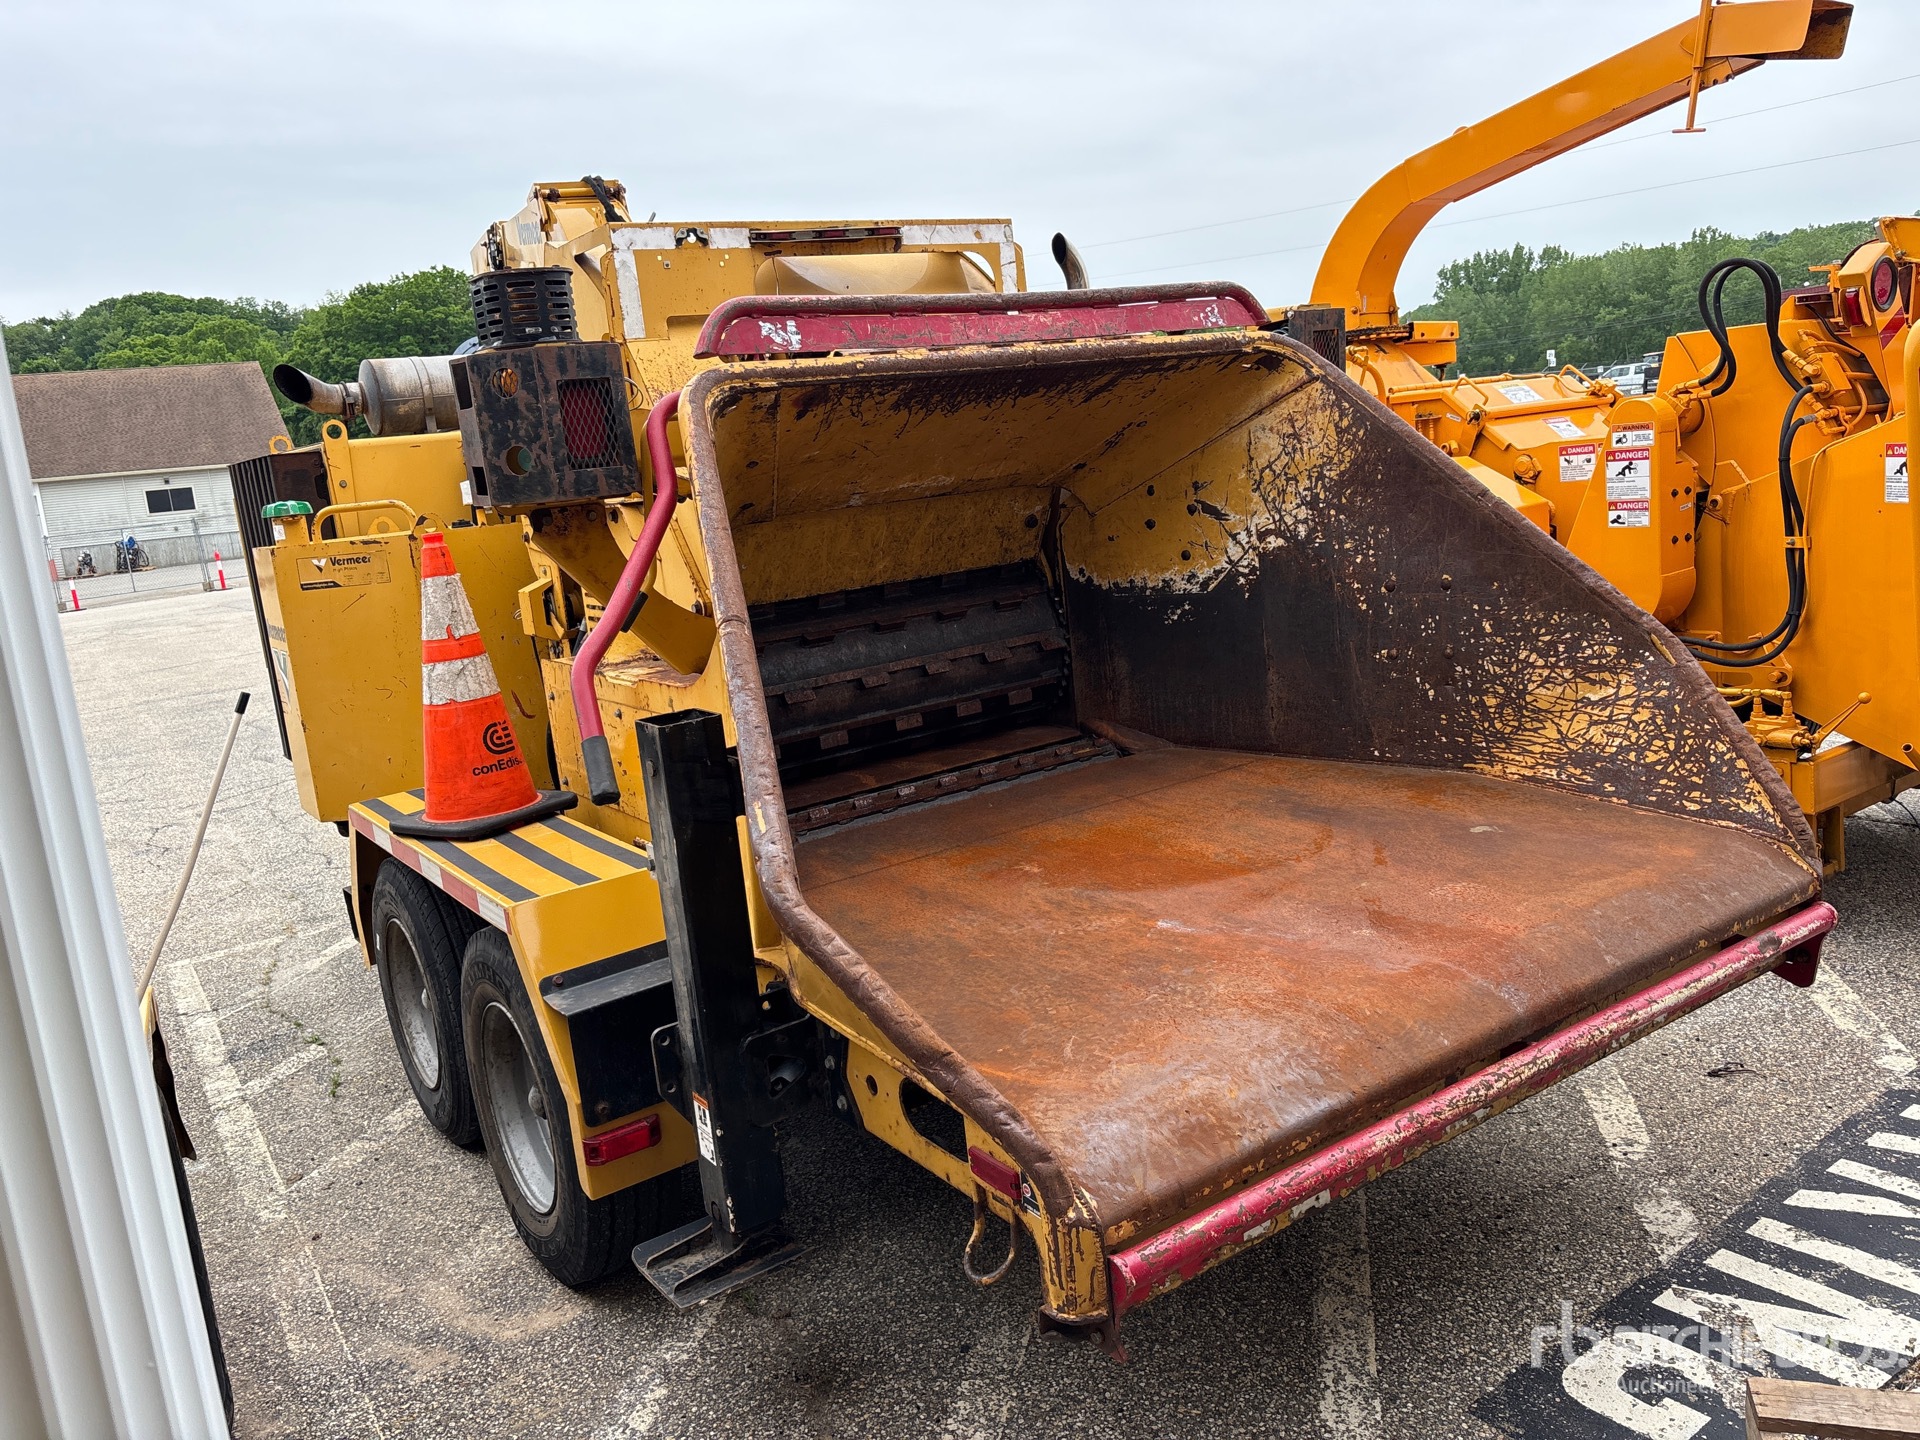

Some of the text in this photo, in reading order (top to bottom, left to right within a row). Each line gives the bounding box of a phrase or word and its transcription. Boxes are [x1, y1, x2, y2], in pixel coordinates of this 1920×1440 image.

[1567, 446, 1594, 454] DANGER
[1615, 450, 1649, 460] DANGER
[1616, 502, 1649, 510] DANGER
[329, 556, 371, 566] Vermeer
